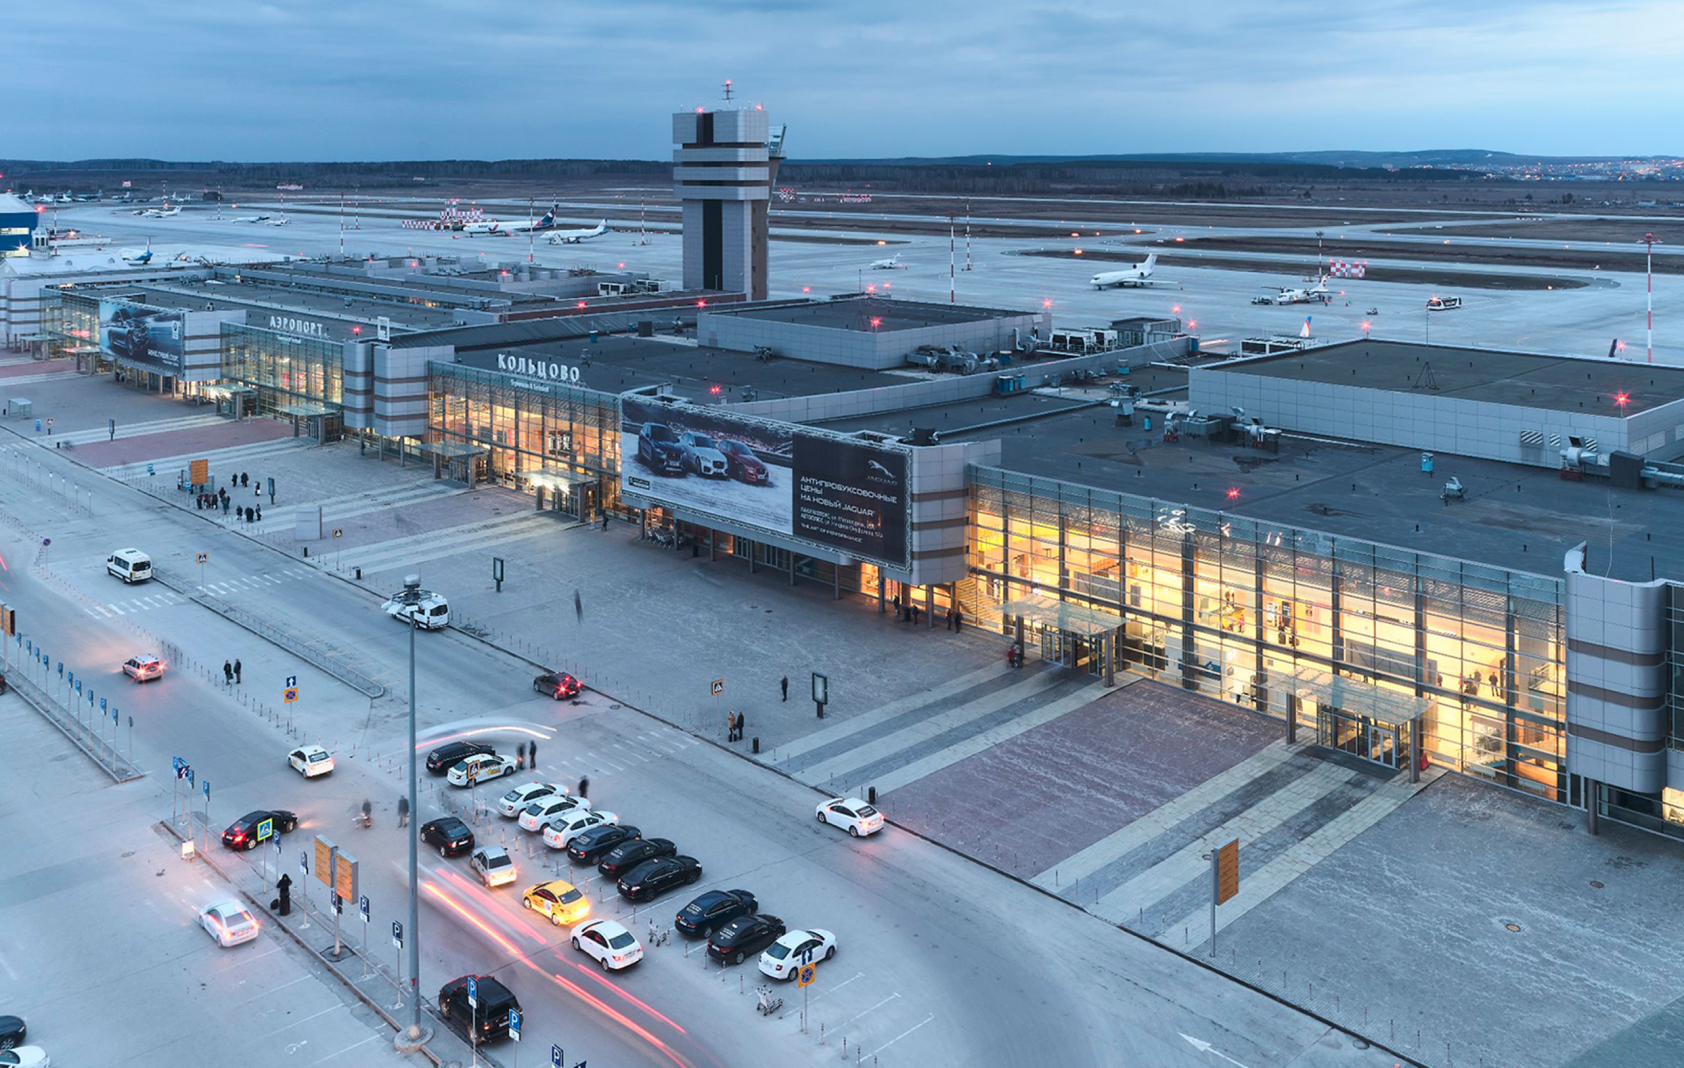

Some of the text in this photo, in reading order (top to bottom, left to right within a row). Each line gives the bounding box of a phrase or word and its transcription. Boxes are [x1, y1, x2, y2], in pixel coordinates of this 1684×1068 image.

[270, 316, 323, 336] АЭРОПОРТ
[498, 353, 580, 382] КОЛЬЦОВО
[800, 484, 823, 494] ЦЕНЫ
[800, 476, 898, 503] АНТИПРОБУКСОВОЧНЫЕ
[800, 494, 811, 502] НА
[812, 496, 842, 509] НОВЫЙ
